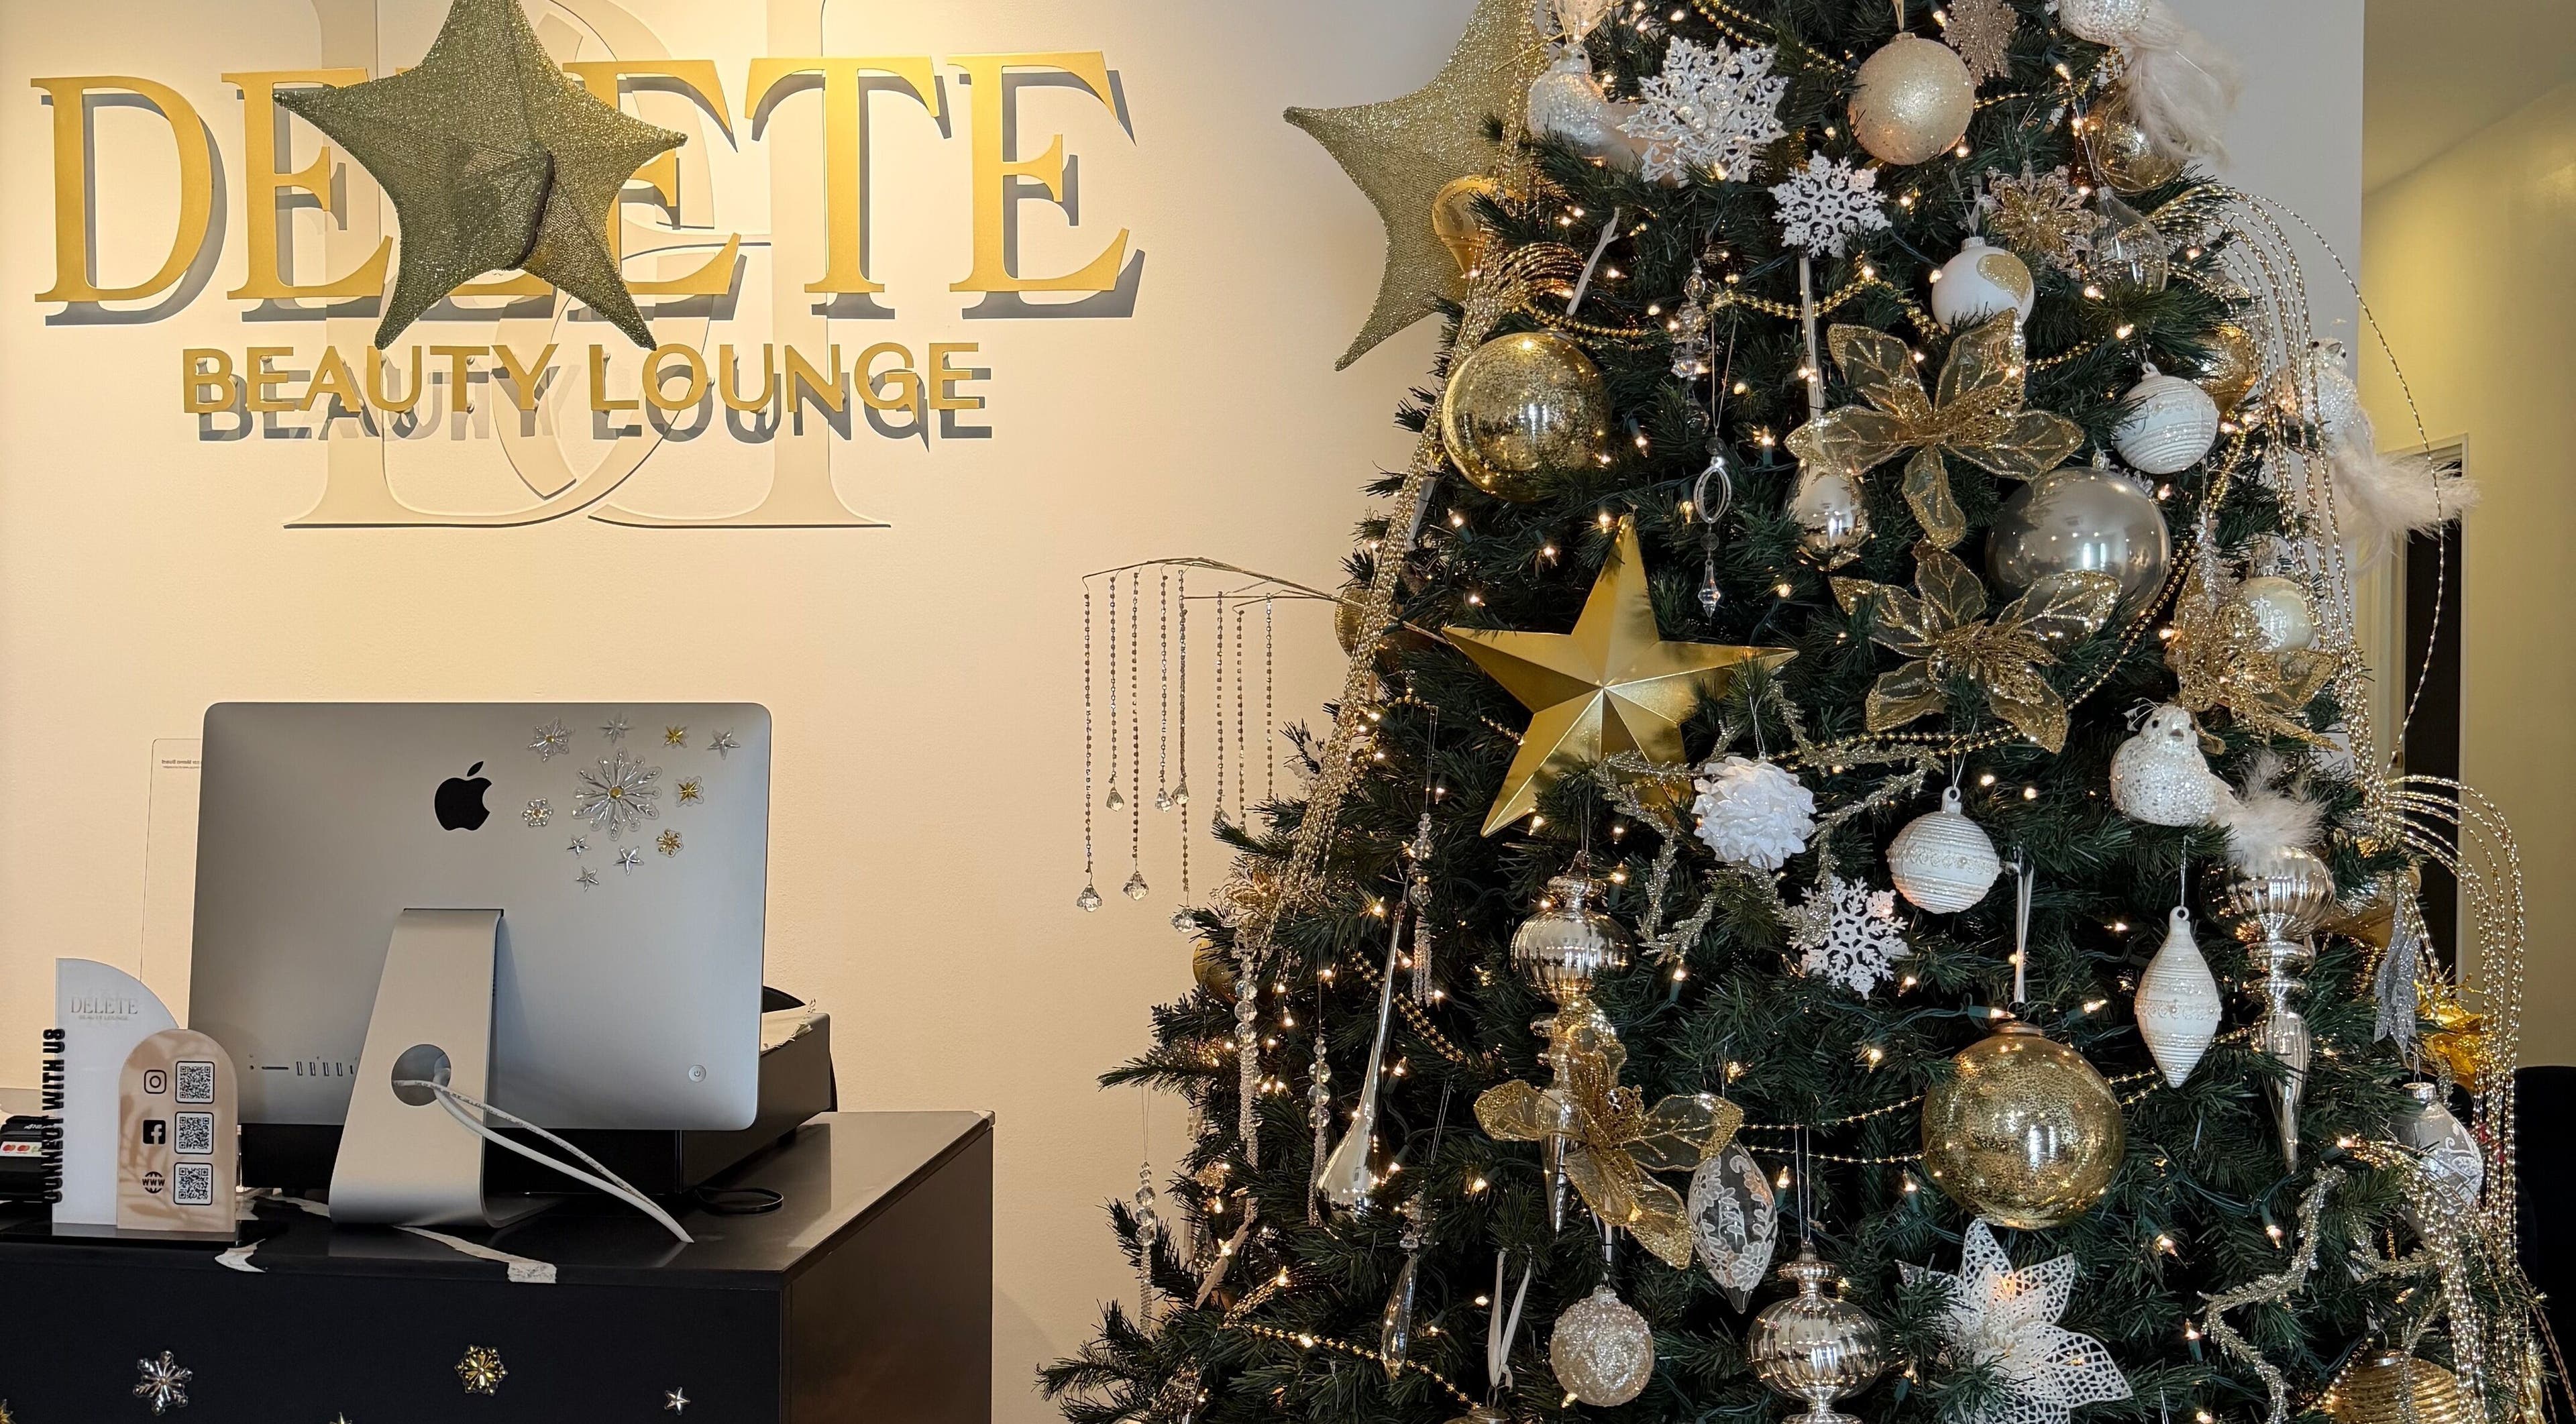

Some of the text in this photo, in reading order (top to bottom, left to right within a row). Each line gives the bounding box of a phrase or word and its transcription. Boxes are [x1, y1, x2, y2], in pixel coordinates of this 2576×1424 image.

[31, 51, 1129, 302] DEETE
[182, 343, 979, 422] BEAUTY LOUNGE
[70, 997, 138, 1014] DELETE
[42, 1059, 64, 1111] WITH
